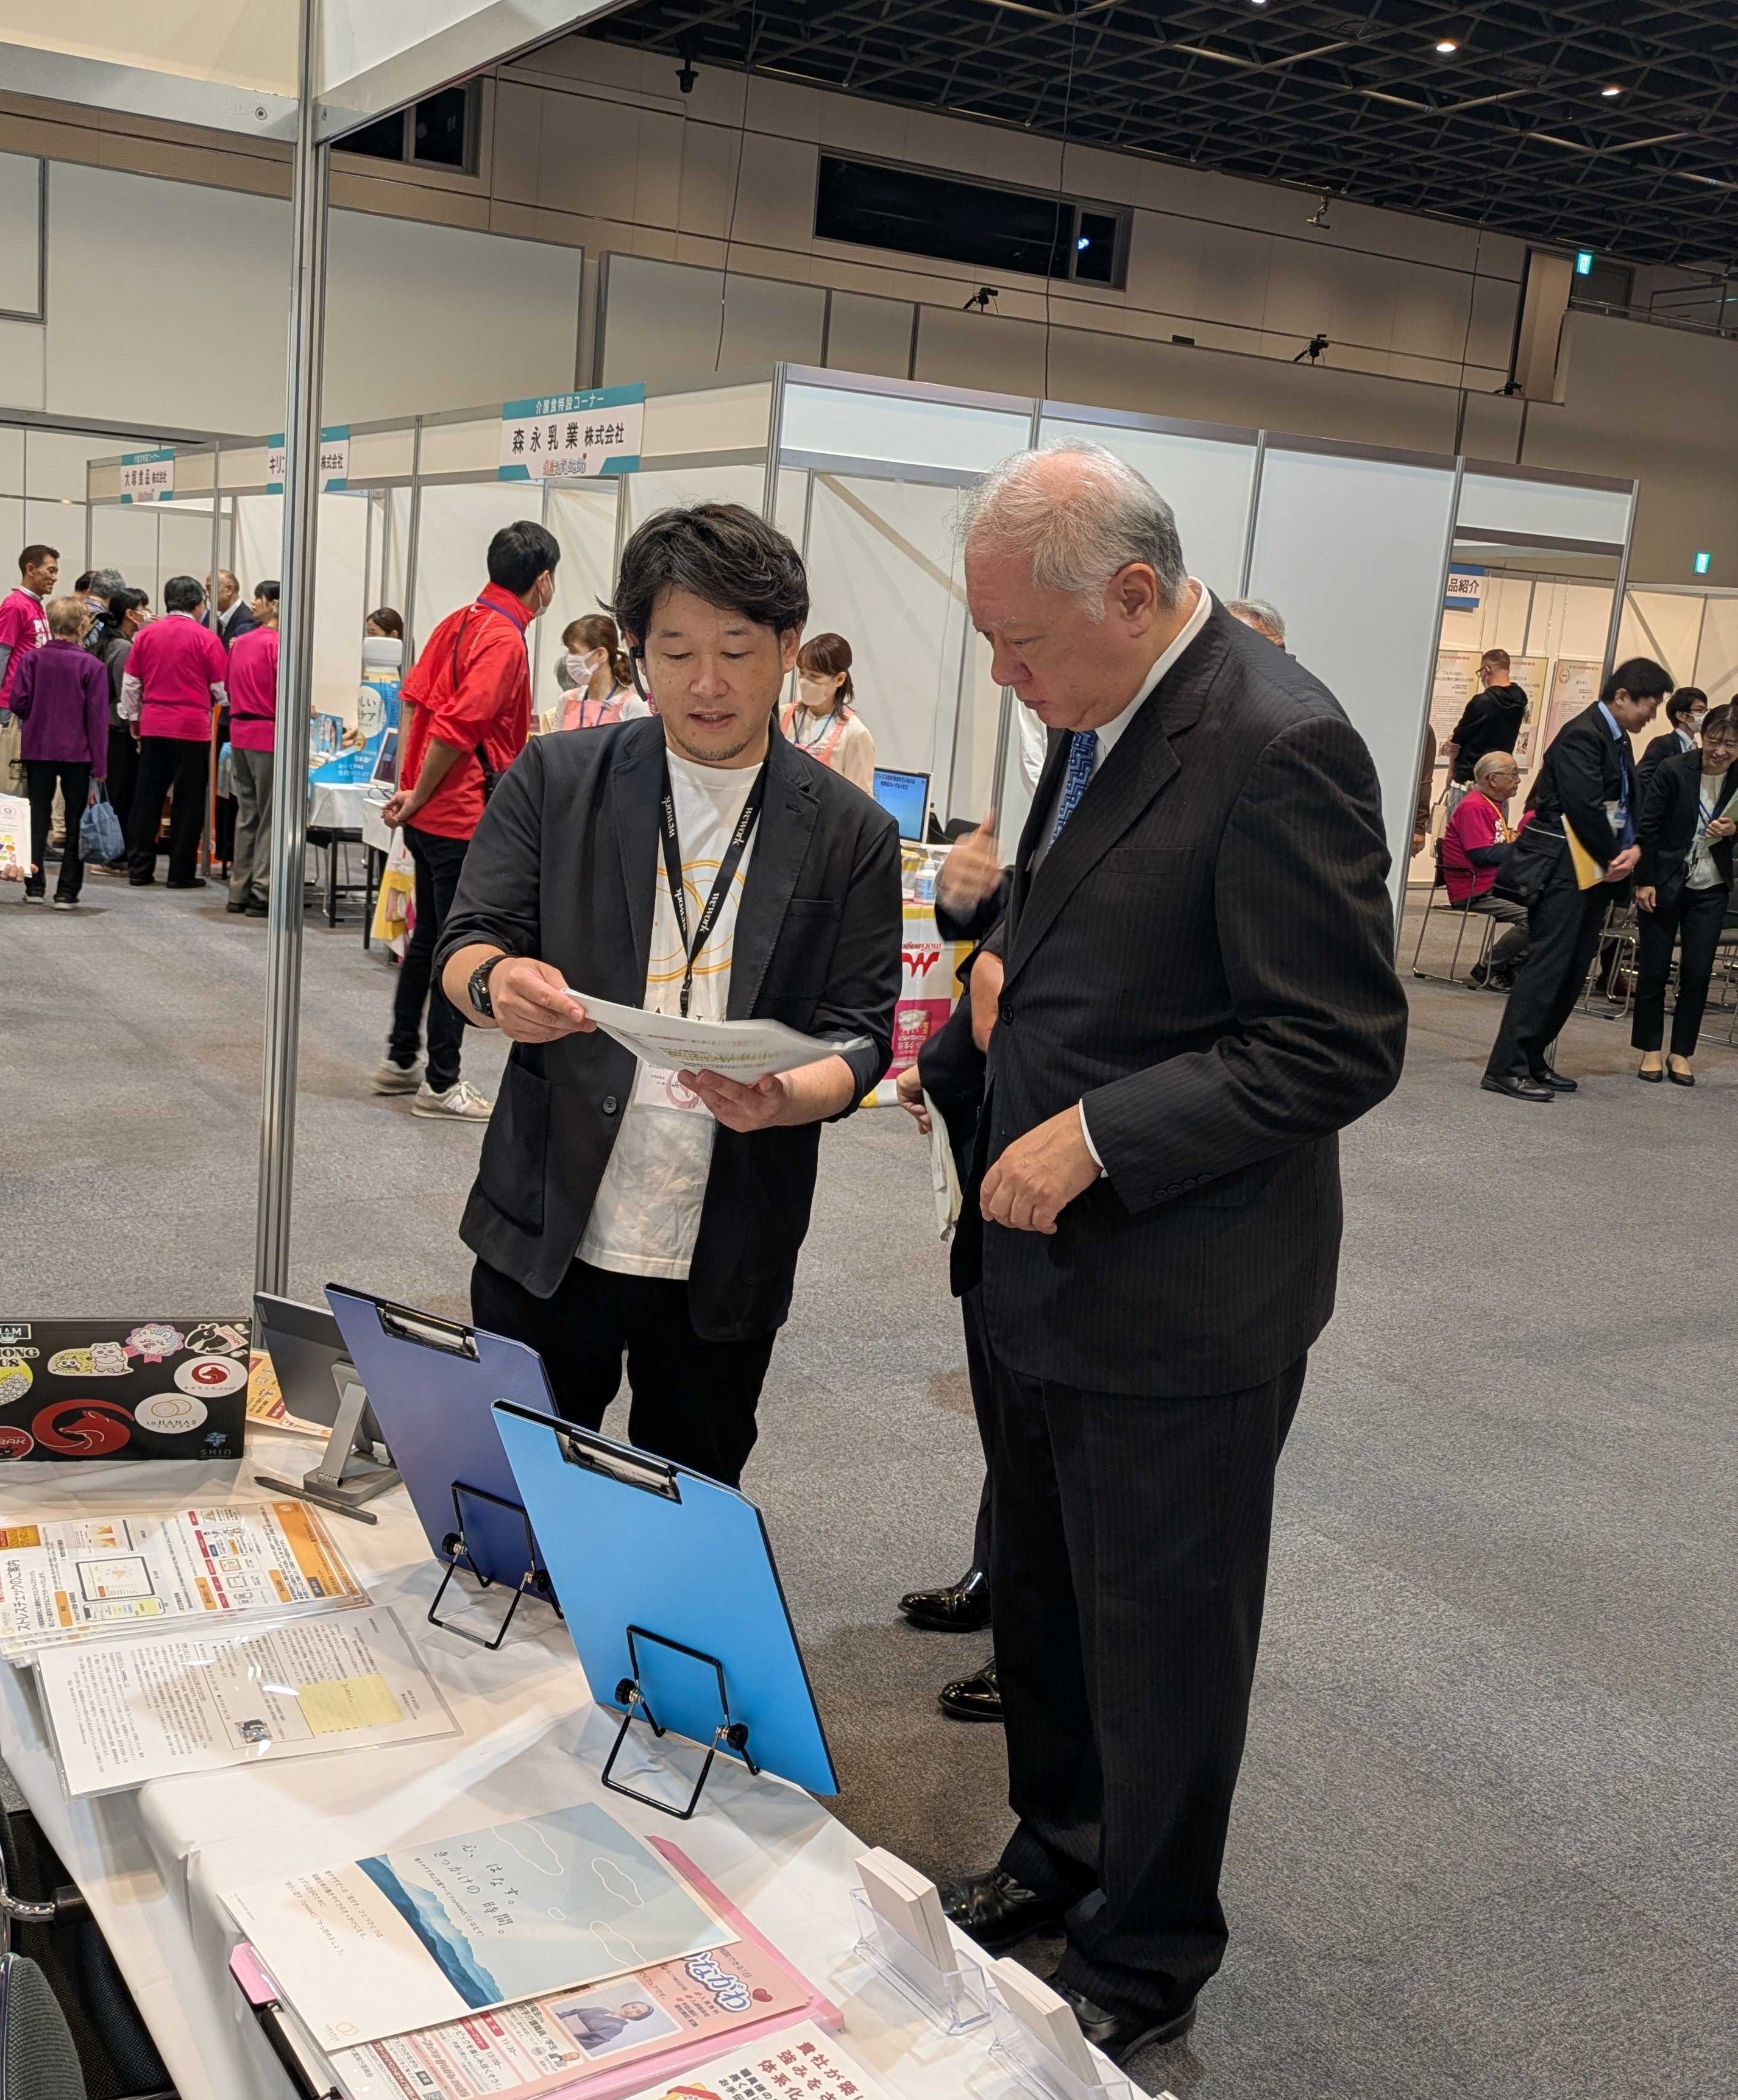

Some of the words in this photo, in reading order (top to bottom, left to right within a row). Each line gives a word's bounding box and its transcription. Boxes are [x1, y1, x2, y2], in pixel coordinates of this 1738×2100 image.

[536, 394, 605, 415] 介護食特設コーナー
[512, 422, 579, 454] 森永乳業
[584, 422, 625, 447] 株式会社
[321, 453, 343, 470] 株式会社
[1448, 578, 1480, 595] 品紹介
[661, 795, 675, 838] wework
[732, 807, 753, 846] wework
[674, 887, 687, 932] wework
[699, 893, 720, 933] wework
[0, 1327, 22, 1336] AM
[0, 1348, 38, 1357] ONG
[6, 1560, 30, 1632] ストレスチェックのご案内
[433, 1850, 481, 1894] きっかけの
[478, 1901, 519, 1934] 時間。
[485, 1862, 525, 1905] はなす。
[688, 1951, 751, 2011] ながわ
